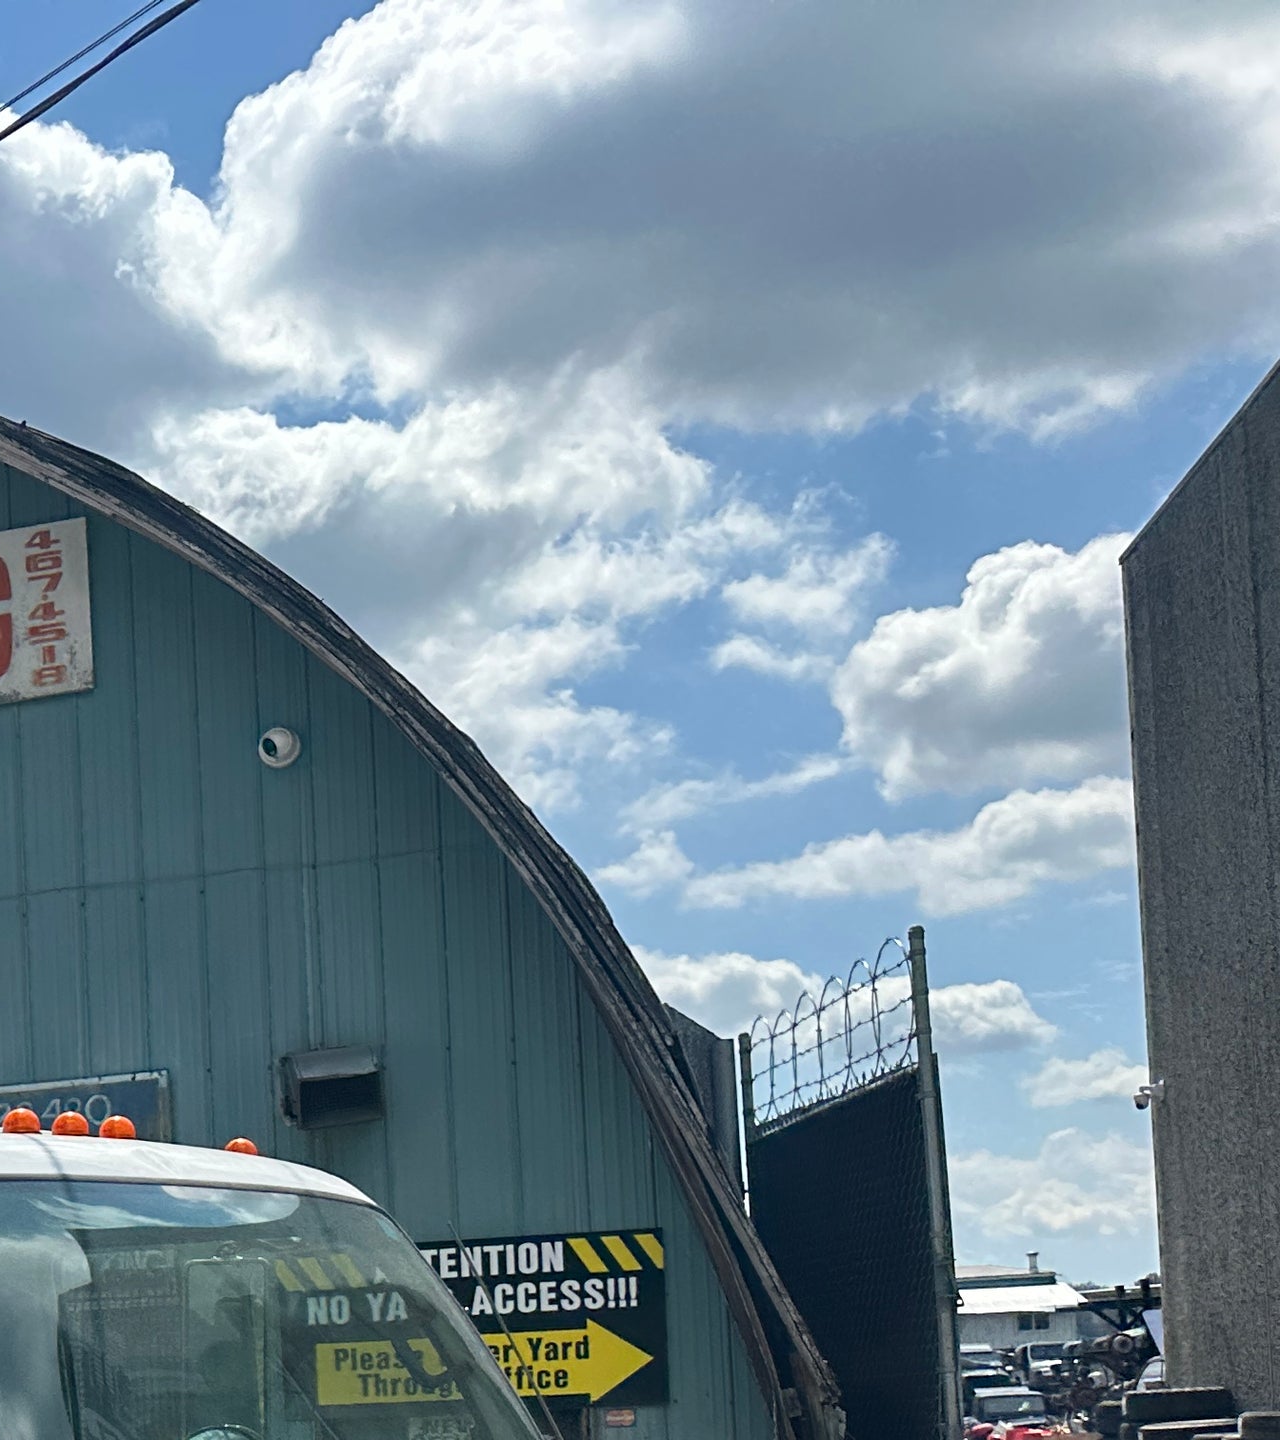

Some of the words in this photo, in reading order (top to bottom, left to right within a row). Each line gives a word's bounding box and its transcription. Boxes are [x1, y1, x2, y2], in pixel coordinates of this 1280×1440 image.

[306, 1294, 351, 1326] NO
[471, 1276, 638, 1316] ACCESS!!!
[527, 1335, 589, 1361] Yard
